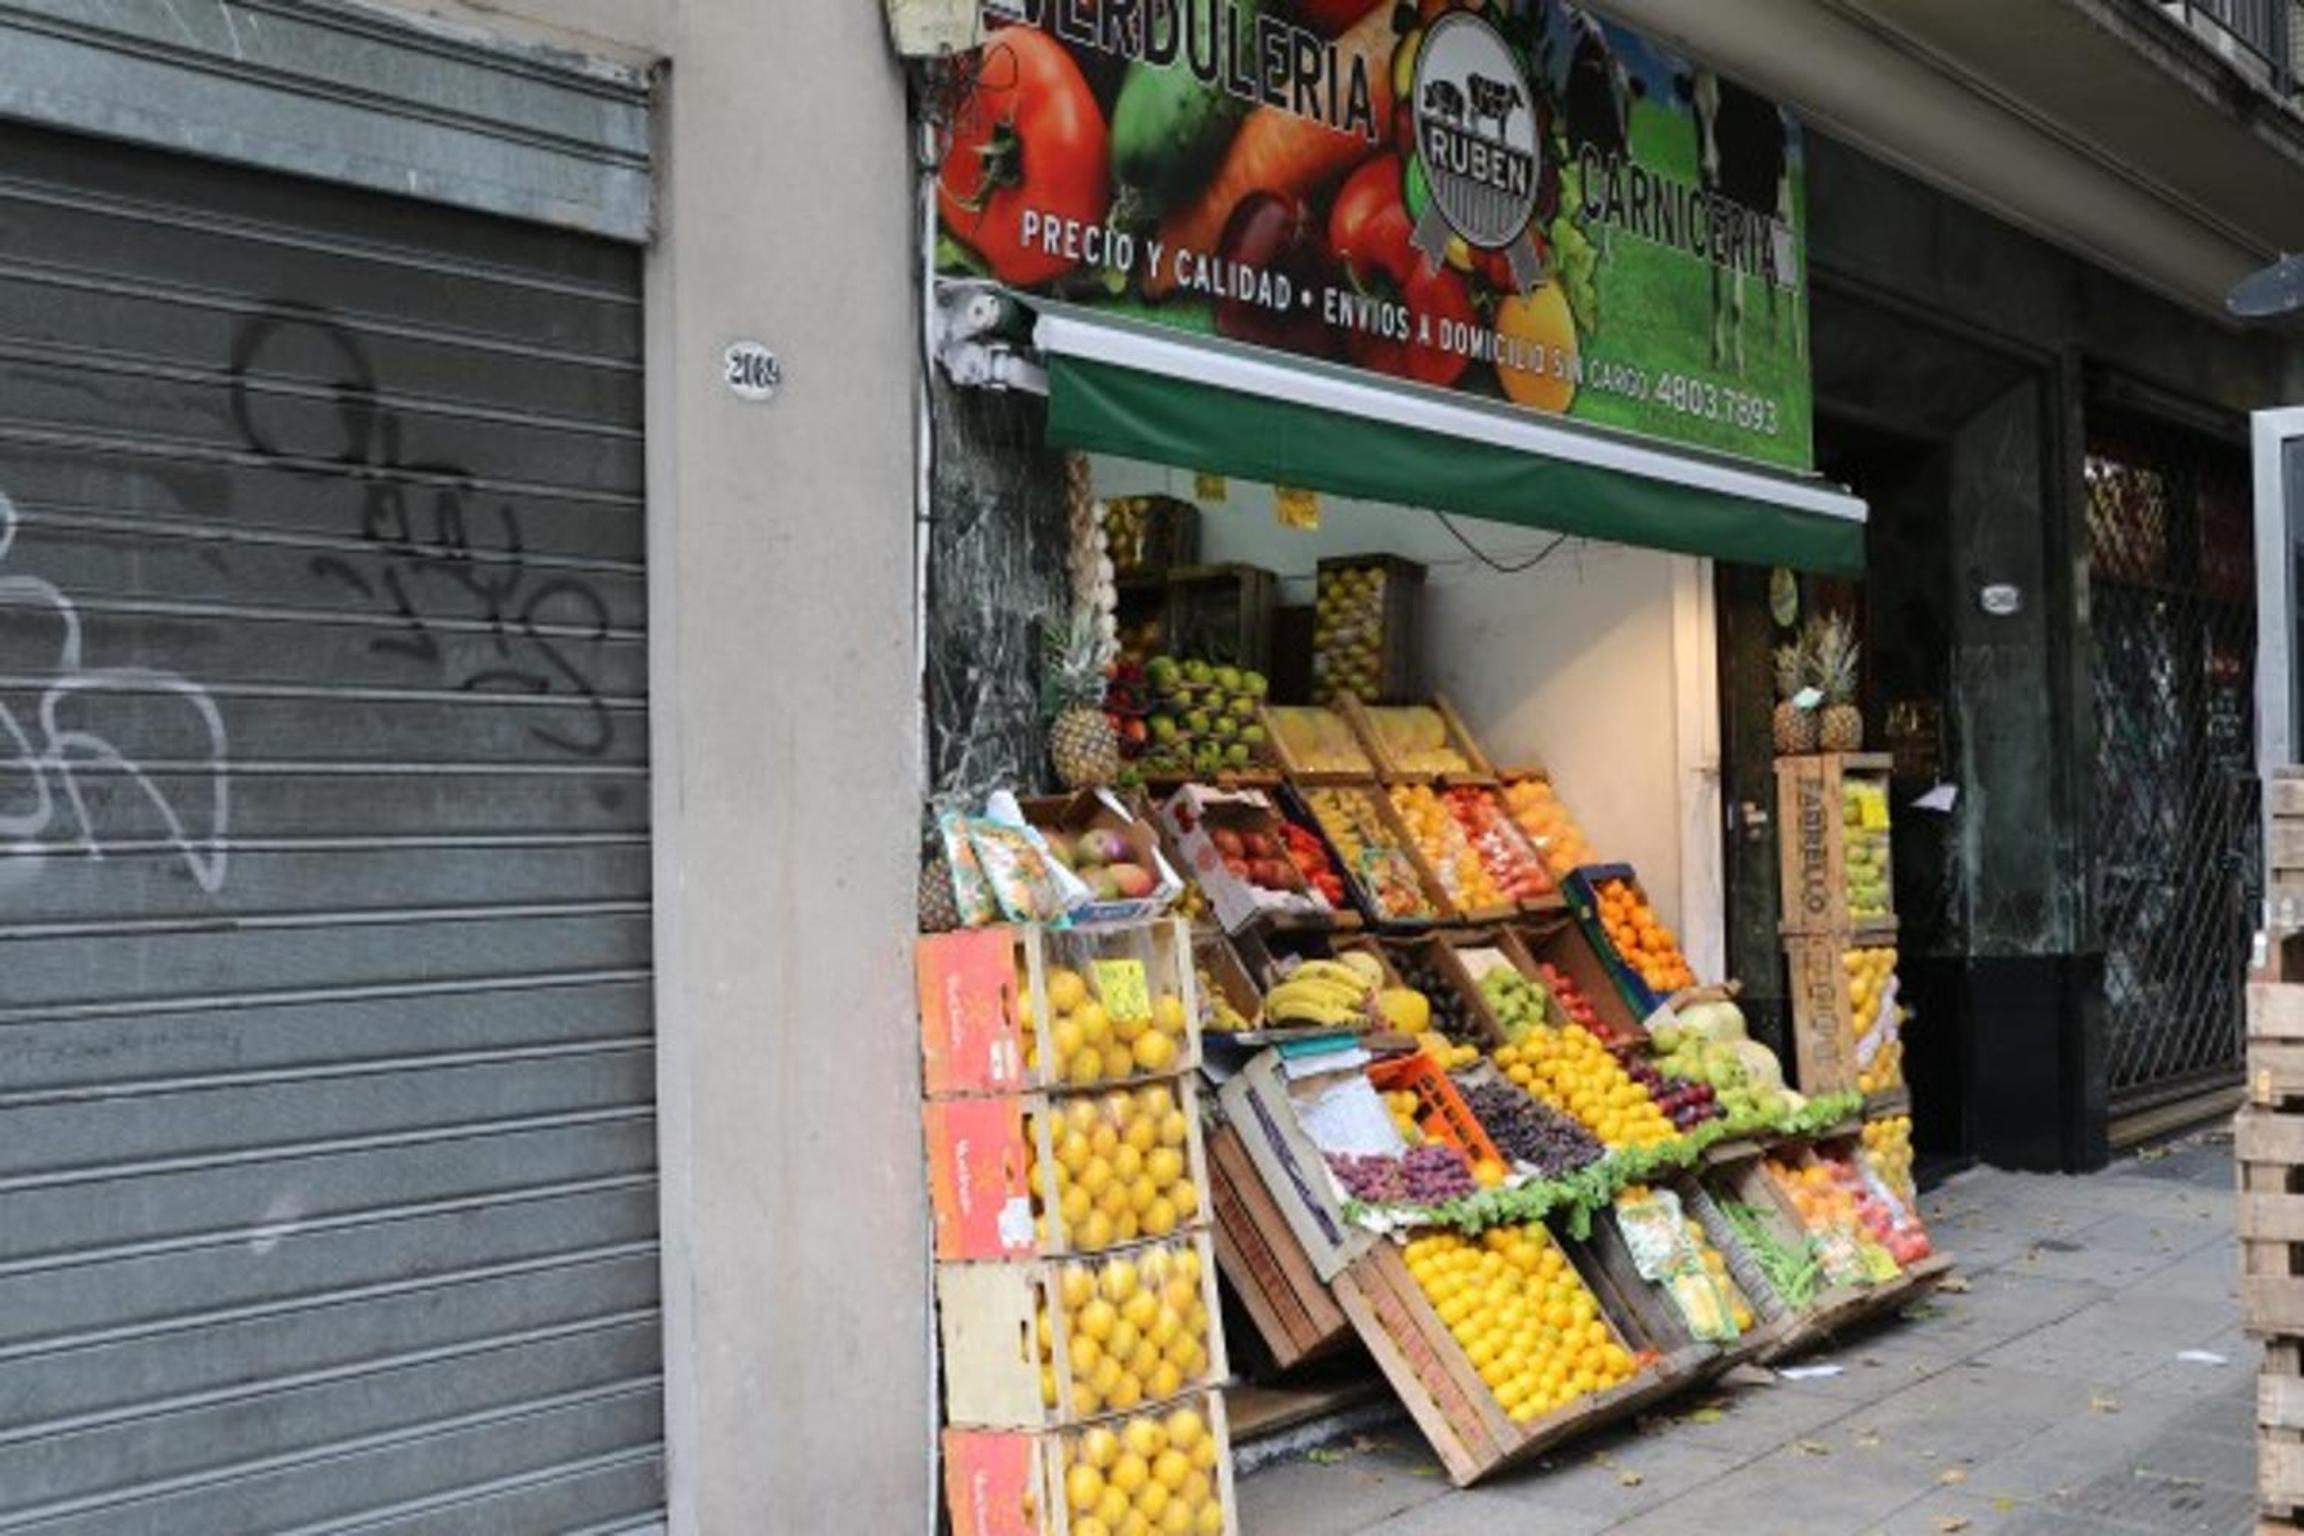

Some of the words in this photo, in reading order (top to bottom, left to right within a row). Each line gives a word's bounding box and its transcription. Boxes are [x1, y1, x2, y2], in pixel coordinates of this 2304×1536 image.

[1022, 0, 1379, 143] RDULERIA
[1428, 127, 1528, 198] RUBEN
[1020, 209, 1134, 272] PRECIO
[1147, 240, 1165, 279] Y
[1174, 249, 1293, 311] CALIDAD
[1323, 286, 1409, 341] ENVIOS
[1418, 314, 1430, 345] A
[1439, 317, 1545, 374] DOMICILIO
[1552, 348, 1583, 385] SIN
